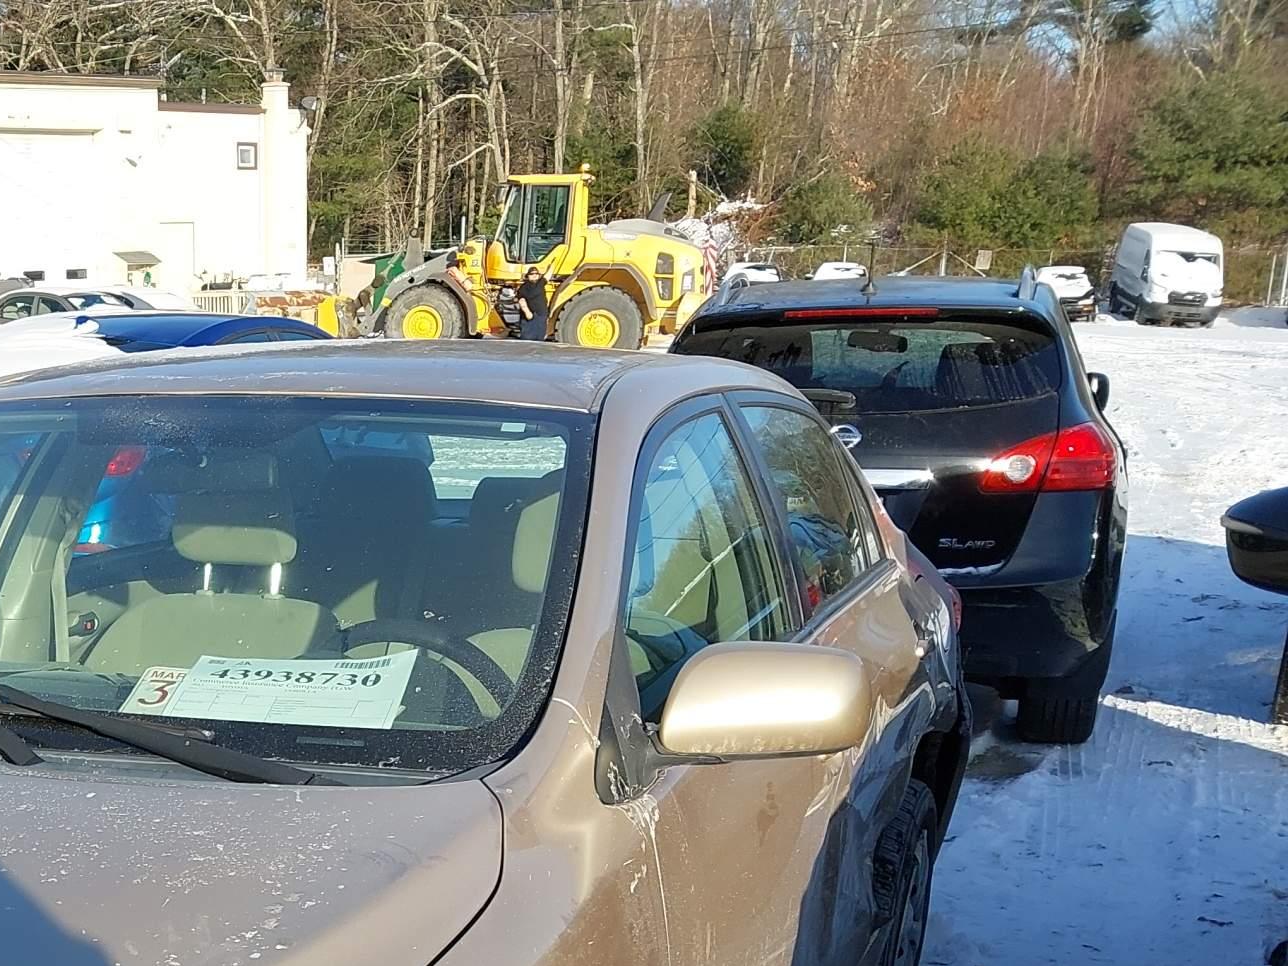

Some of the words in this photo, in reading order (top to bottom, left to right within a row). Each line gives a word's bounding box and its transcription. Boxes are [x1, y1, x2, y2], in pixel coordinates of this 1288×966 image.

[938, 538, 963, 548] SL
[150, 670, 188, 680] MAR
[209, 668, 382, 687] 43938730
[137, 679, 177, 705] 3
